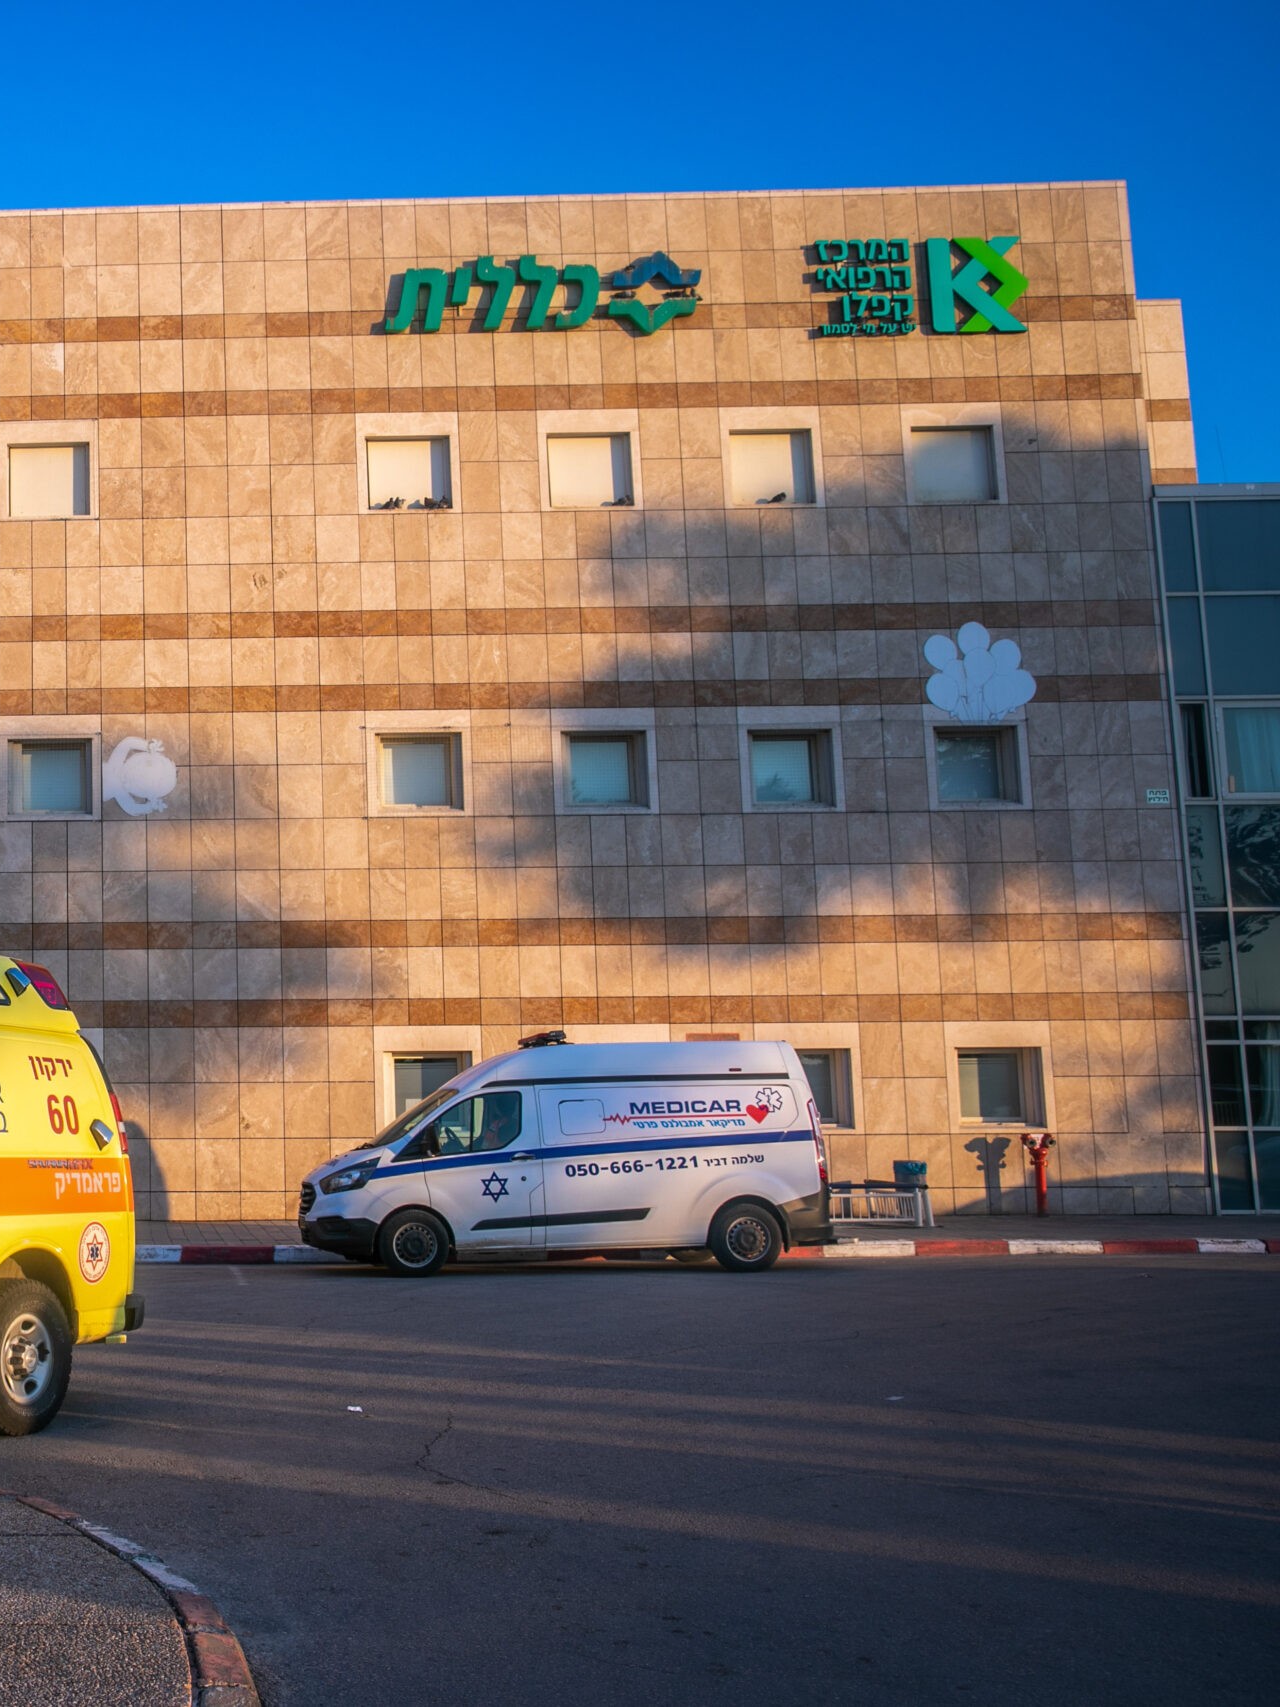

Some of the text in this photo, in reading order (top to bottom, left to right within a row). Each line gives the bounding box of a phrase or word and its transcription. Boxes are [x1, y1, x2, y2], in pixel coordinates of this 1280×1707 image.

[814, 238, 911, 262] המרכז
[815, 265, 912, 289] הרפואי
[385, 254, 601, 333] כללית
[842, 291, 915, 322] קפלן
[28, 1055, 73, 1082] ירקון
[46, 1094, 80, 1136] 60
[629, 1099, 742, 1115] MEDICAR
[633, 1118, 746, 1129] מדיקאר אמבולנס פרטי
[564, 1153, 765, 1178] שלמה דביר 050-666-1221
[54, 1171, 121, 1201] פראמדיק
